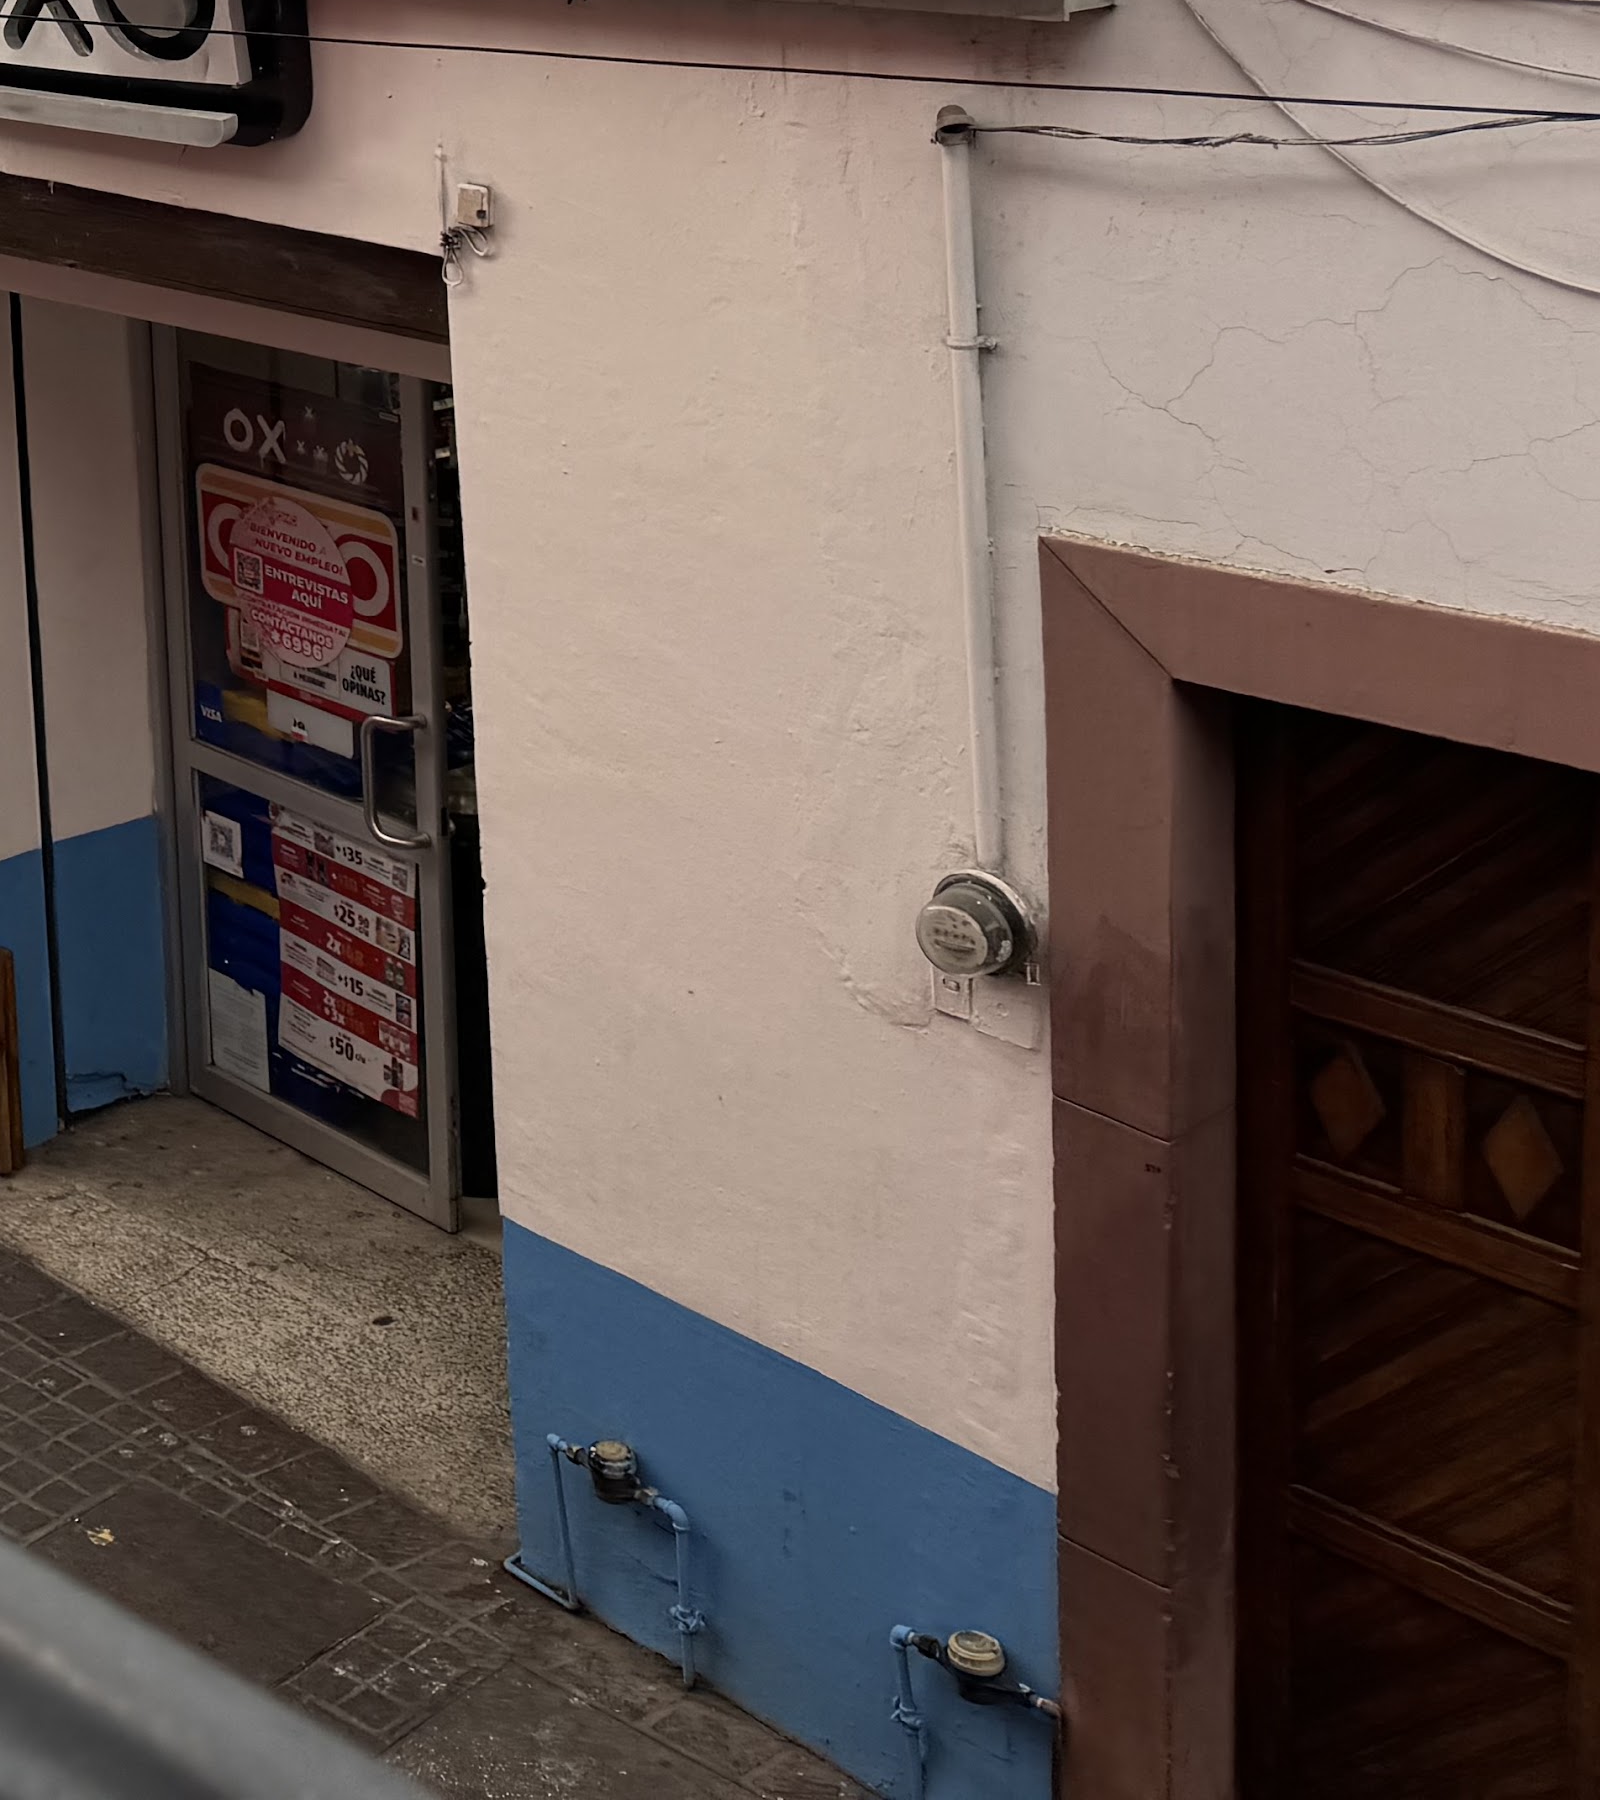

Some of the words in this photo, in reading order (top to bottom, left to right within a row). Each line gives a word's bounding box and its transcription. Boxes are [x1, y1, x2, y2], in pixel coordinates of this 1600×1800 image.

[256, 538, 292, 557] NUEVO
[295, 551, 343, 576] EMPLEO!
[264, 564, 350, 604] ENTREVISTAS
[292, 589, 322, 610] AQUÍ
[251, 609, 333, 649] CONTÁCTANOS
[350, 664, 376, 684] ¿QUÉ
[343, 678, 386, 705] OPINAS?
[200, 704, 223, 723] VISA
